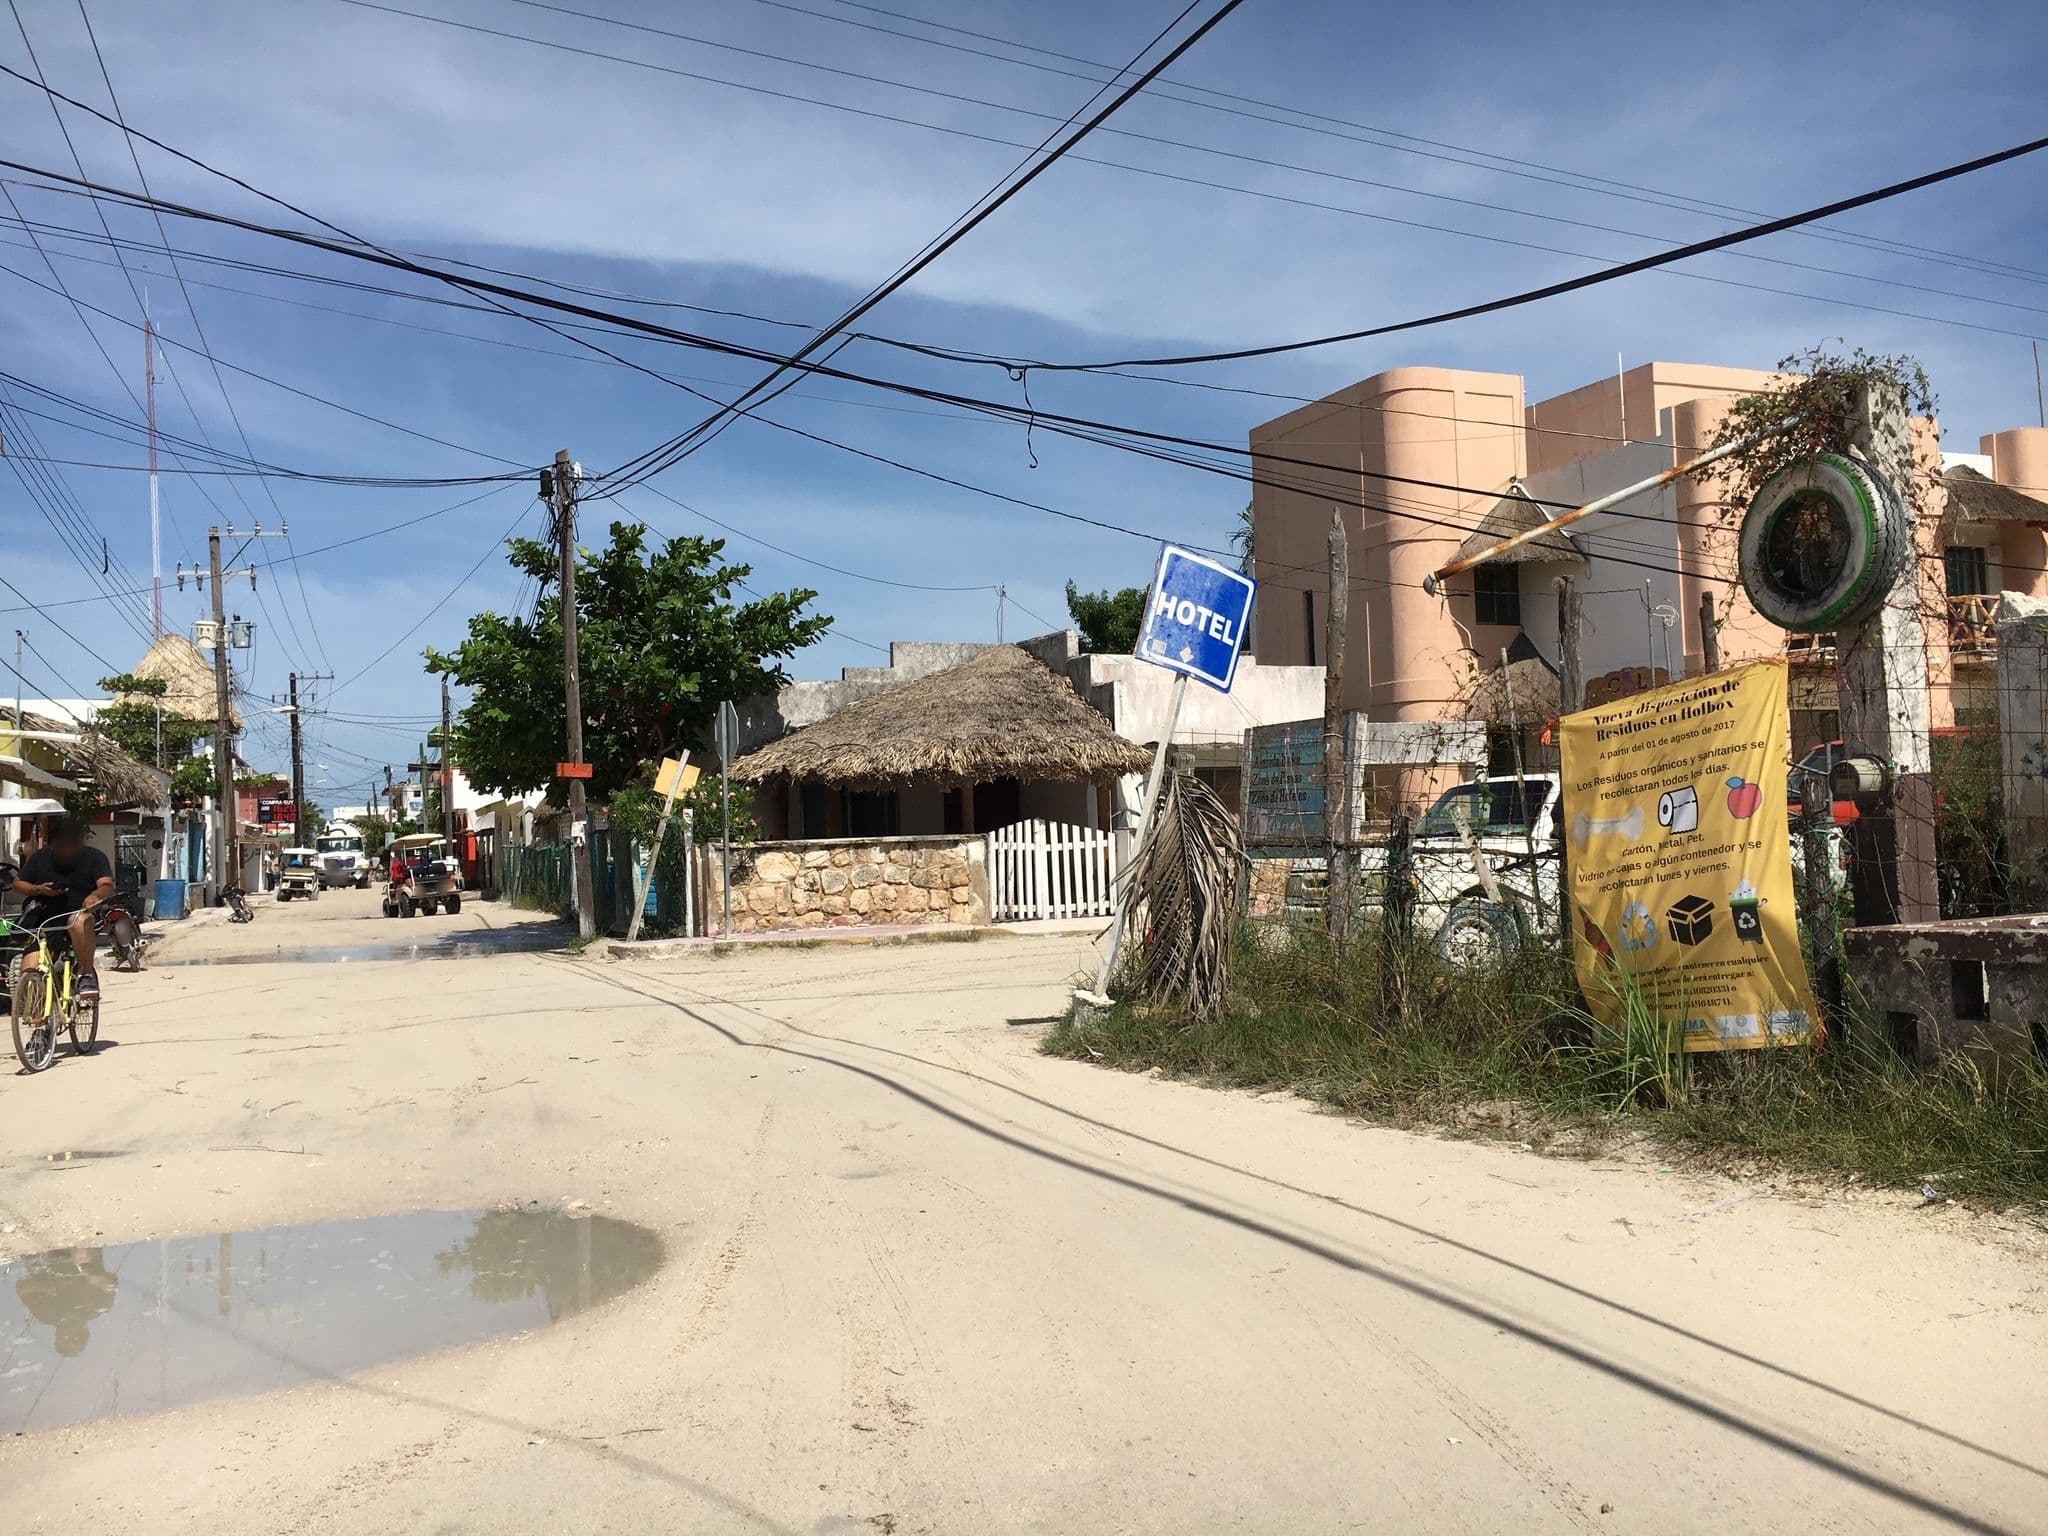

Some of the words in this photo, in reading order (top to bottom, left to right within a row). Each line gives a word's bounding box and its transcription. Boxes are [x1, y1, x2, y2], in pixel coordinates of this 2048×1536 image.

[1156, 591, 1234, 647] HOTEL
[1593, 709, 1632, 726] Nueva
[1635, 687, 1718, 715] disposición
[1721, 680, 1740, 693] de
[1596, 718, 1657, 742] Residuos
[1660, 713, 1677, 726] en
[1681, 700, 1735, 721] Holbox
[1599, 752, 1606, 760] A
[1607, 745, 1630, 760] partir
[1631, 741, 1645, 753] del
[1646, 740, 1656, 749] 01
[1658, 737, 1668, 747] de
[1670, 731, 1699, 744] agosto
[1701, 726, 1712, 736] de
[1713, 720, 1735, 733] 2017
[1576, 780, 1593, 792] Los
[1593, 768, 1638, 787] Residuos
[1640, 757, 1688, 777] orgánicos
[1689, 756, 1697, 766] y
[1697, 742, 1748, 762] sanitarios
[1750, 739, 1765, 751] se
[1599, 780, 1660, 801] recolectaran
[1661, 773, 1689, 787] todos
[1690, 768, 1703, 780] los
[1705, 763, 1730, 776] días.
[1579, 870, 1604, 883] Vidrio
[1616, 862, 1642, 876] cajas
[1645, 861, 1651, 869] o
[1651, 854, 1679, 869] algún
[1680, 843, 1735, 862] contenedor
[1739, 842, 1746, 853] y
[1748, 840, 1762, 849] se
[1622, 844, 1656, 858] Cartón,
[1658, 836, 1685, 849] Metal,
[1687, 833, 1705, 845] Pet.
[1656, 871, 1682, 884] lunes
[1684, 868, 1691, 880] y
[1692, 861, 1730, 875] viernes.
[1709, 970, 1745, 982] entregar
[1727, 955, 1768, 969] cualquier
